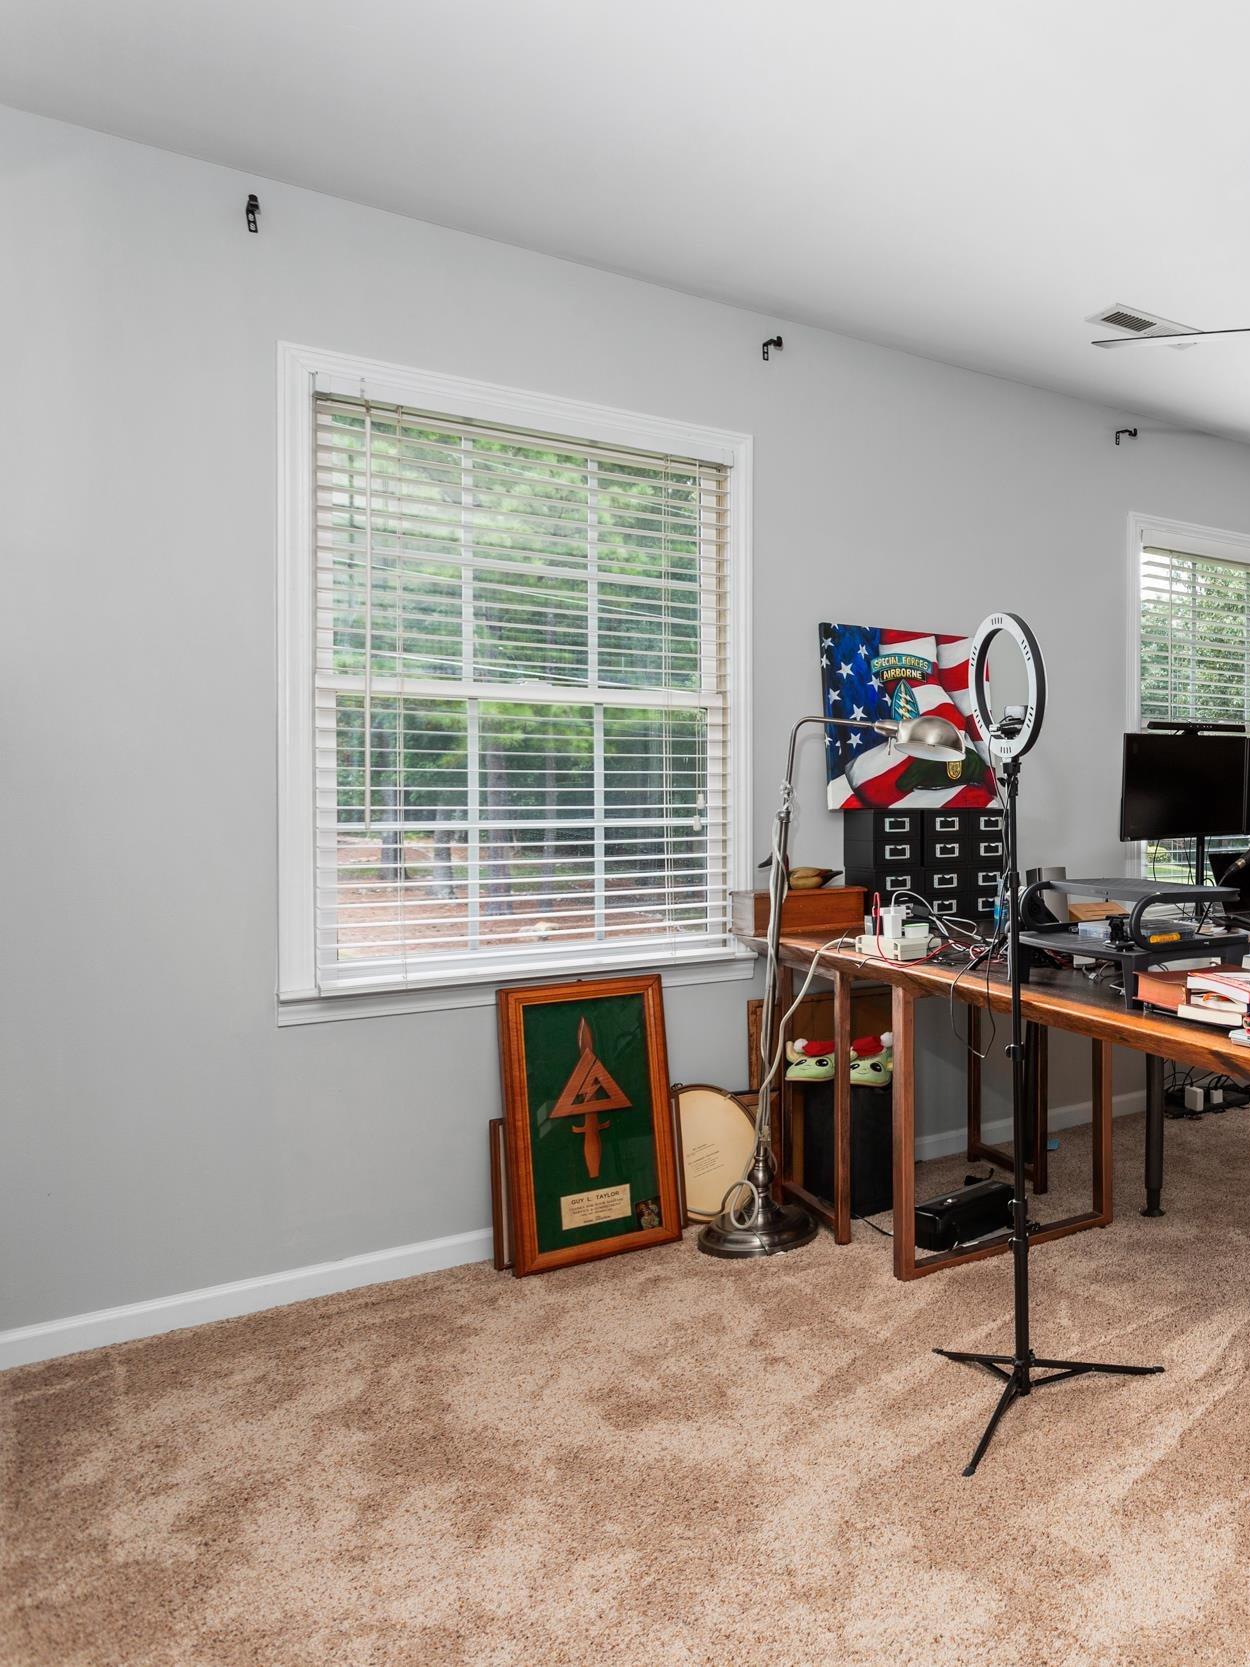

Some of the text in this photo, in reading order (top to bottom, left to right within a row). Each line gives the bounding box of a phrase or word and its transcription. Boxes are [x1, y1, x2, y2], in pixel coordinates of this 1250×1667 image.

[874, 656, 928, 670] SPECIAL FORCES
[883, 668, 922, 680] AIRBORNE
[571, 1198, 584, 1206] GUY
[596, 1190, 620, 1200] TAYLOR
